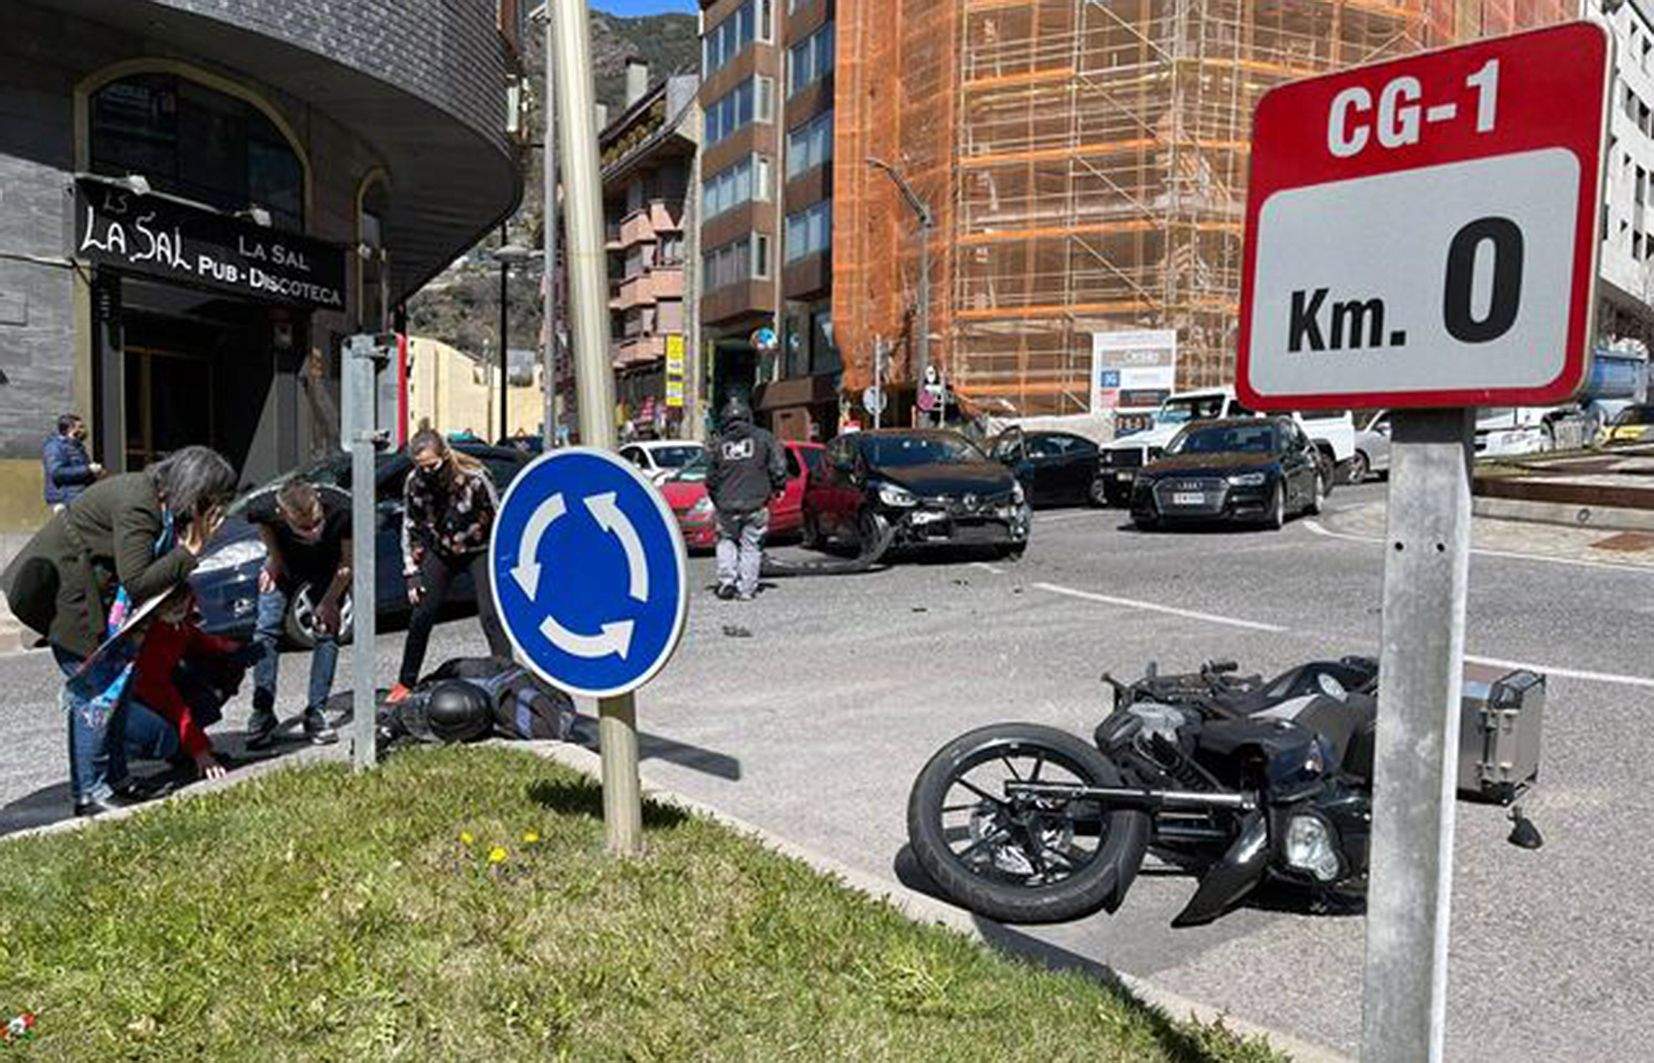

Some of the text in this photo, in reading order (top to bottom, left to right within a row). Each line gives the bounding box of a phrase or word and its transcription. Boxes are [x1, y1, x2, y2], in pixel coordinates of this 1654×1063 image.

[1328, 59, 1499, 157] CG-1
[80, 205, 126, 255] LA
[129, 211, 192, 270] SAL
[198, 255, 238, 283] PUB
[238, 235, 311, 270] LA SAL
[1288, 216, 1524, 352] Km. 0
